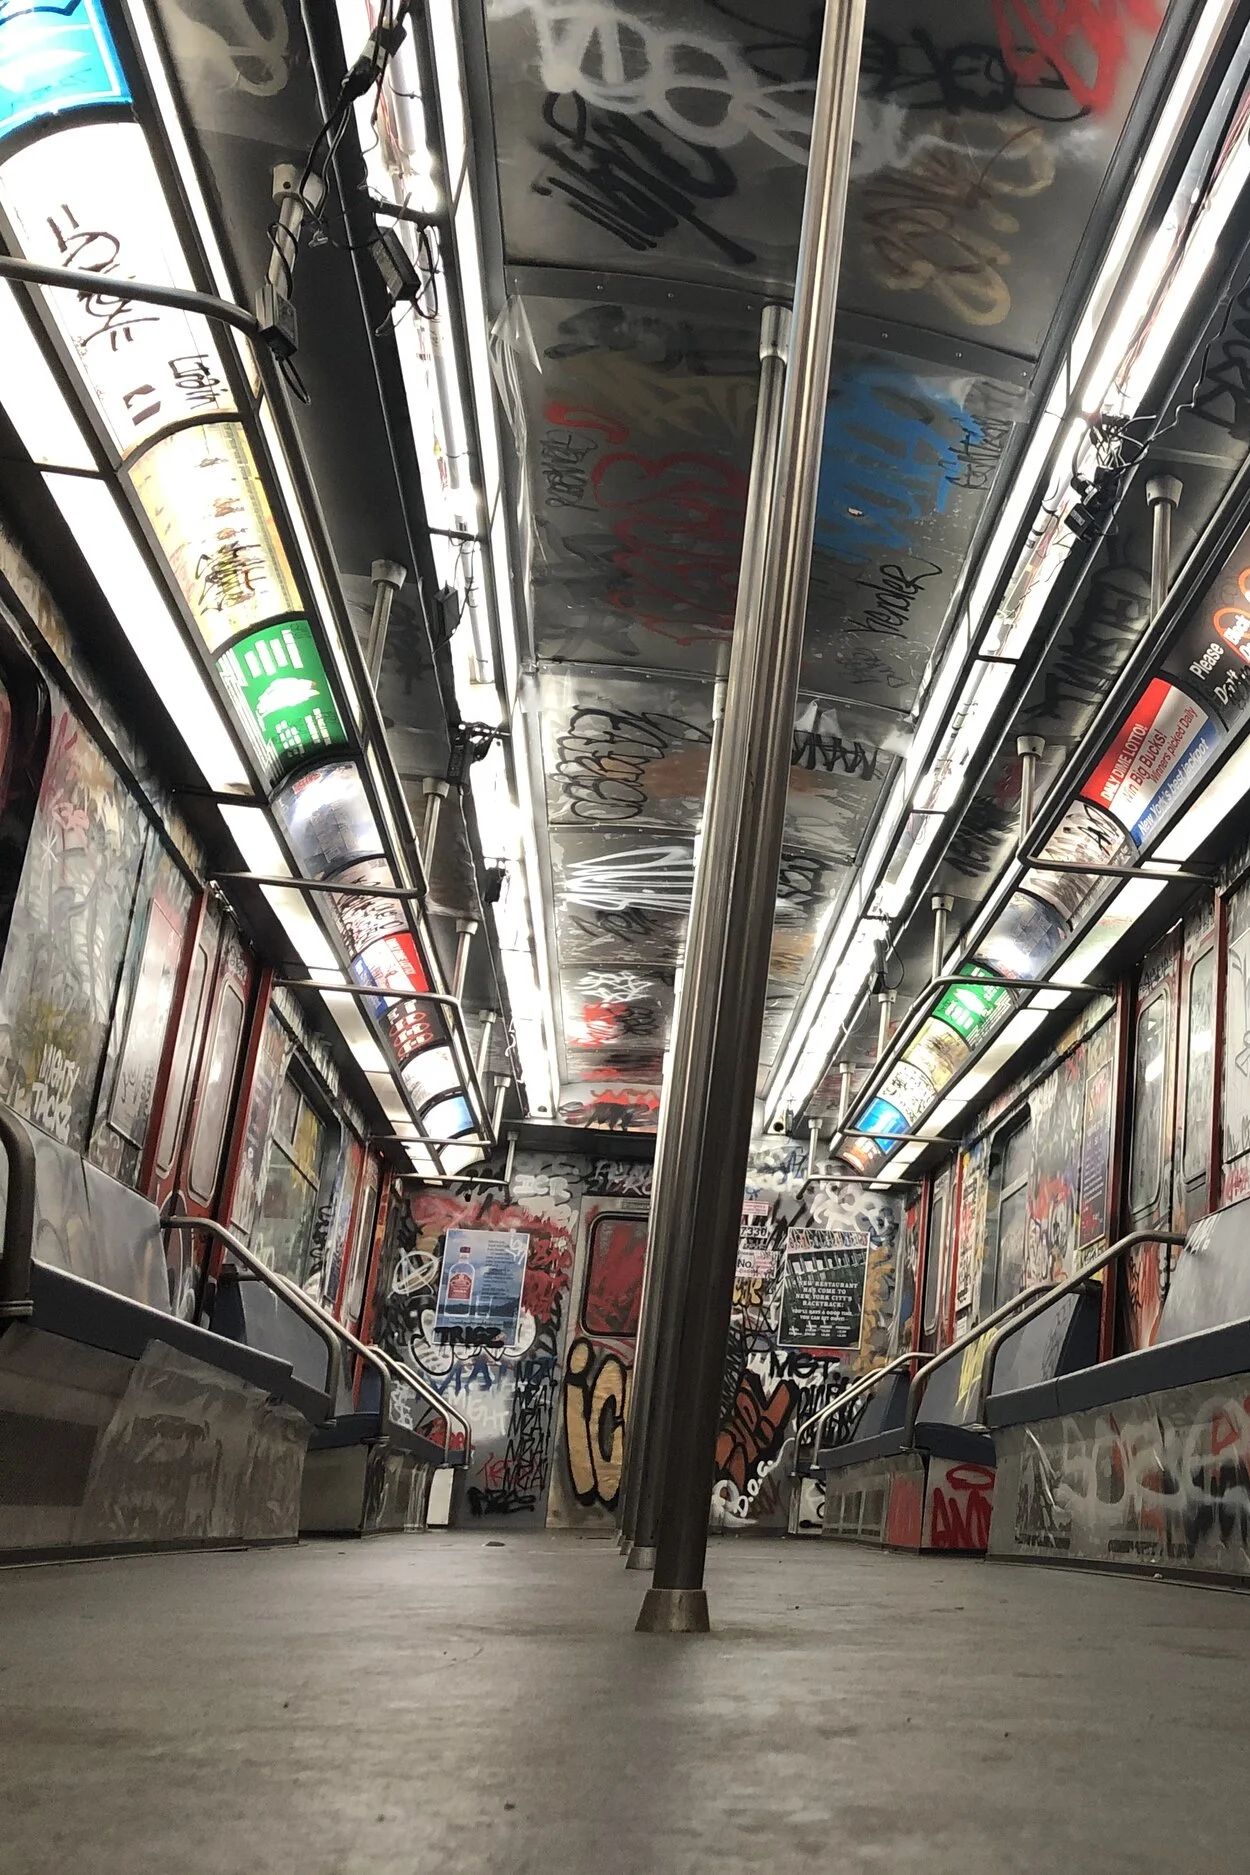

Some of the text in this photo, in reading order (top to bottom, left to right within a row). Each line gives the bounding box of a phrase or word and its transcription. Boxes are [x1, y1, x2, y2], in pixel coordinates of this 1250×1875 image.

[1189, 642, 1225, 681] Please
[1100, 723, 1148, 802] DAILY DIME LOTTO!
[1139, 728, 1167, 769] Bucks!
[1149, 706, 1198, 784] Winners picked Daily
[1130, 766, 1151, 786] Big
[1137, 736, 1209, 837] New York's best jackpot
[740, 1226, 767, 1237] 7330
[803, 1300, 844, 1308] RACETRACK!
[815, 1281, 858, 1289] RESTAURANT
